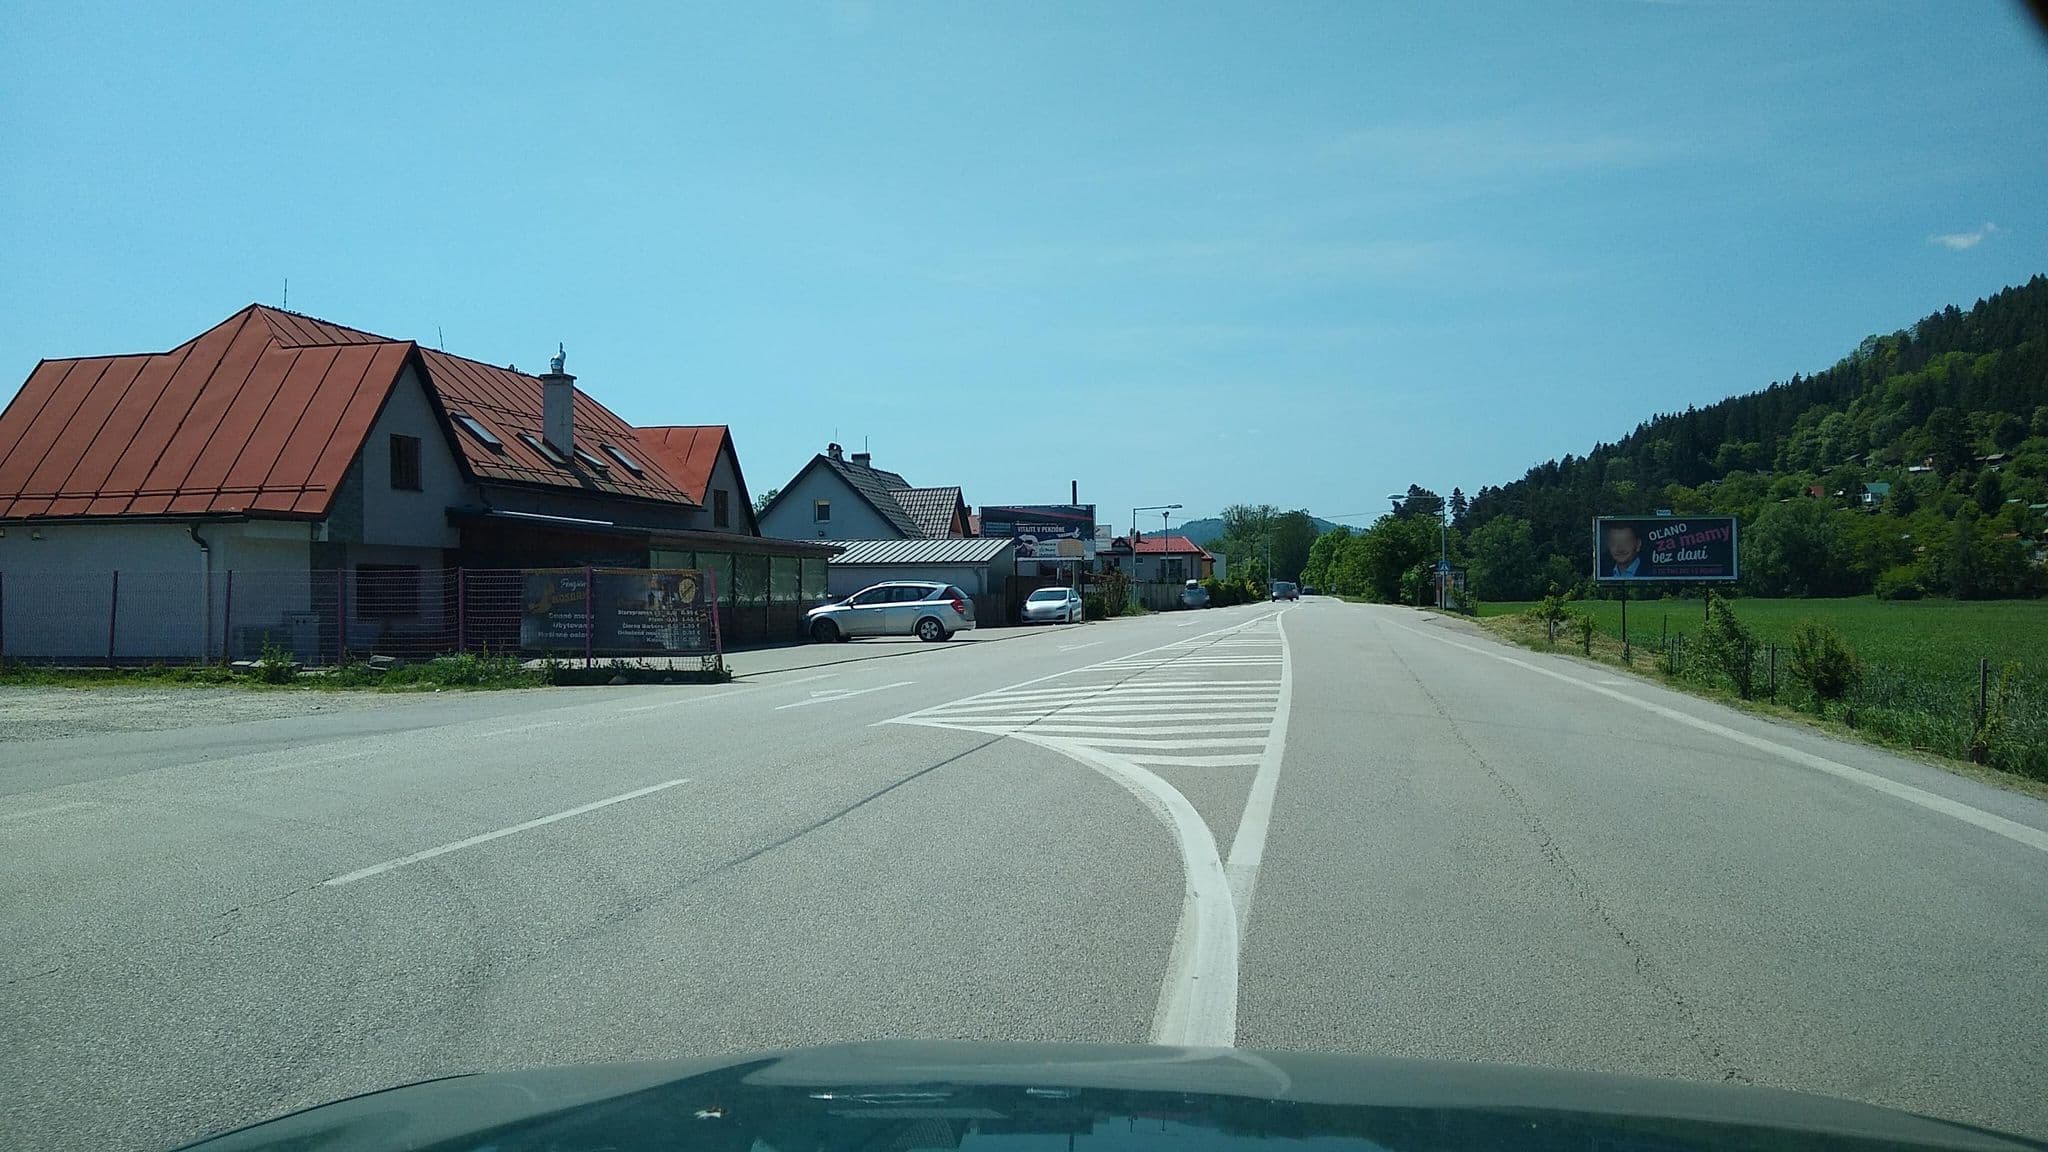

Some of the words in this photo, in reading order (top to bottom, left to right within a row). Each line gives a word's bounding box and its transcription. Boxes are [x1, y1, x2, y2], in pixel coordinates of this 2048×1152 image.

[1656, 538, 1676, 552] za
[1679, 525, 1730, 547] mamy
[1652, 549, 1673, 564] bez
